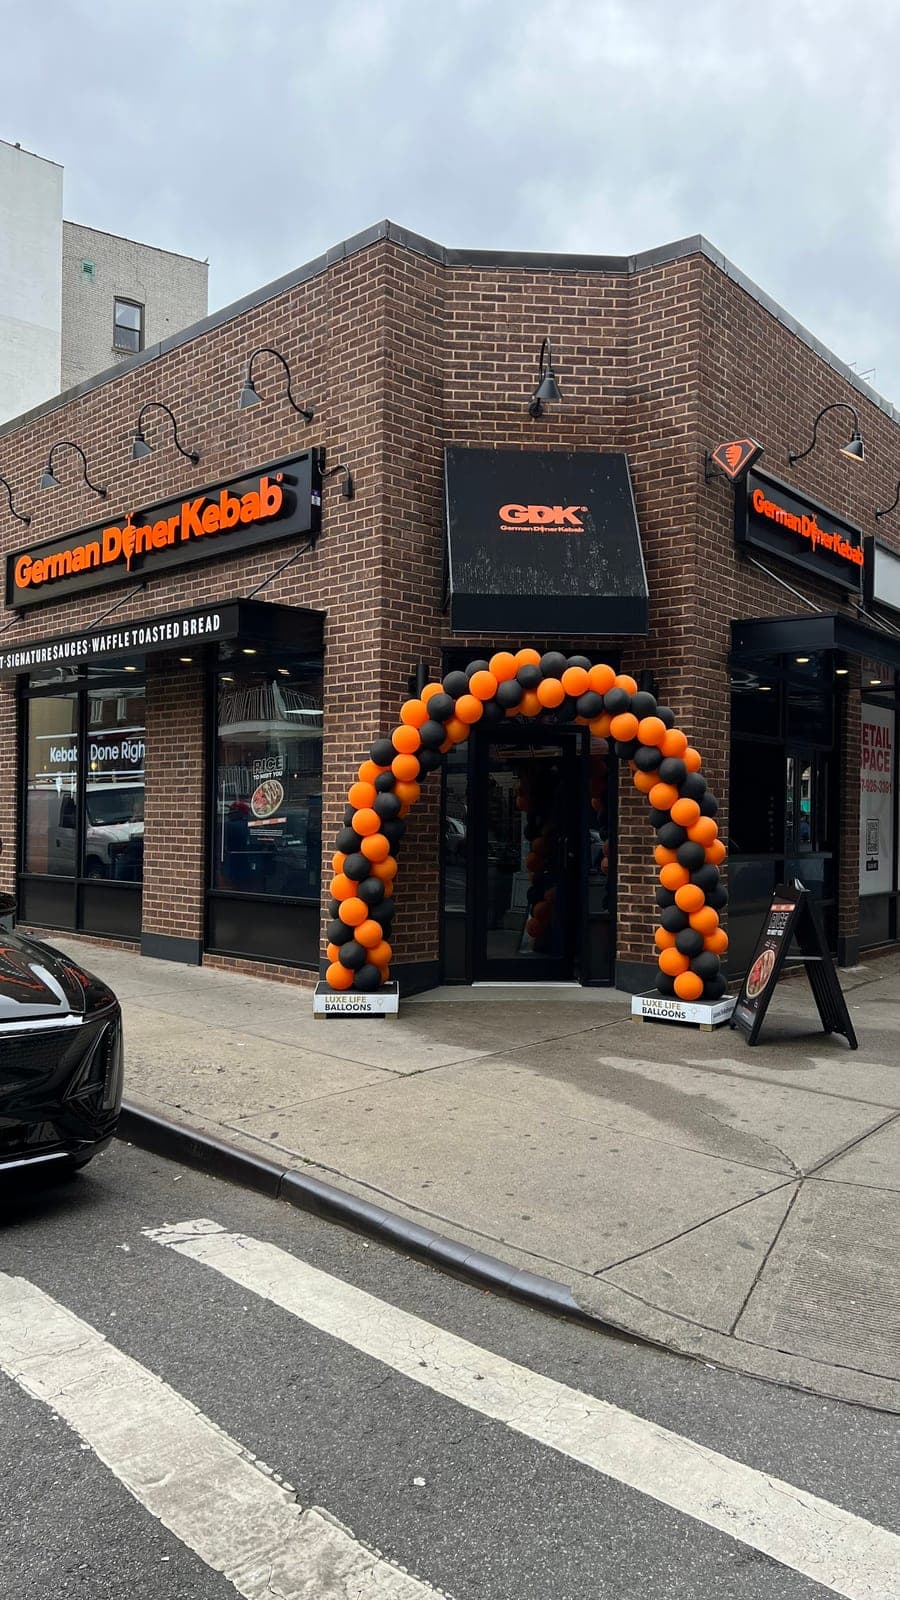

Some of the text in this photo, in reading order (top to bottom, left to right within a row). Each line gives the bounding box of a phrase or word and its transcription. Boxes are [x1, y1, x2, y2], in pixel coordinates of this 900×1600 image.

[498, 503, 584, 525] GDK
[132, 621, 180, 646] TOASTED
[183, 614, 220, 635] BREAD
[90, 744, 119, 761] Done
[253, 755, 284, 774] RICE
[325, 996, 367, 1004] LUXE LIFE
[642, 998, 682, 1011] LUXE LIFE
[325, 1004, 372, 1012] BALLOONS
[642, 1006, 687, 1020] BALLOONS
